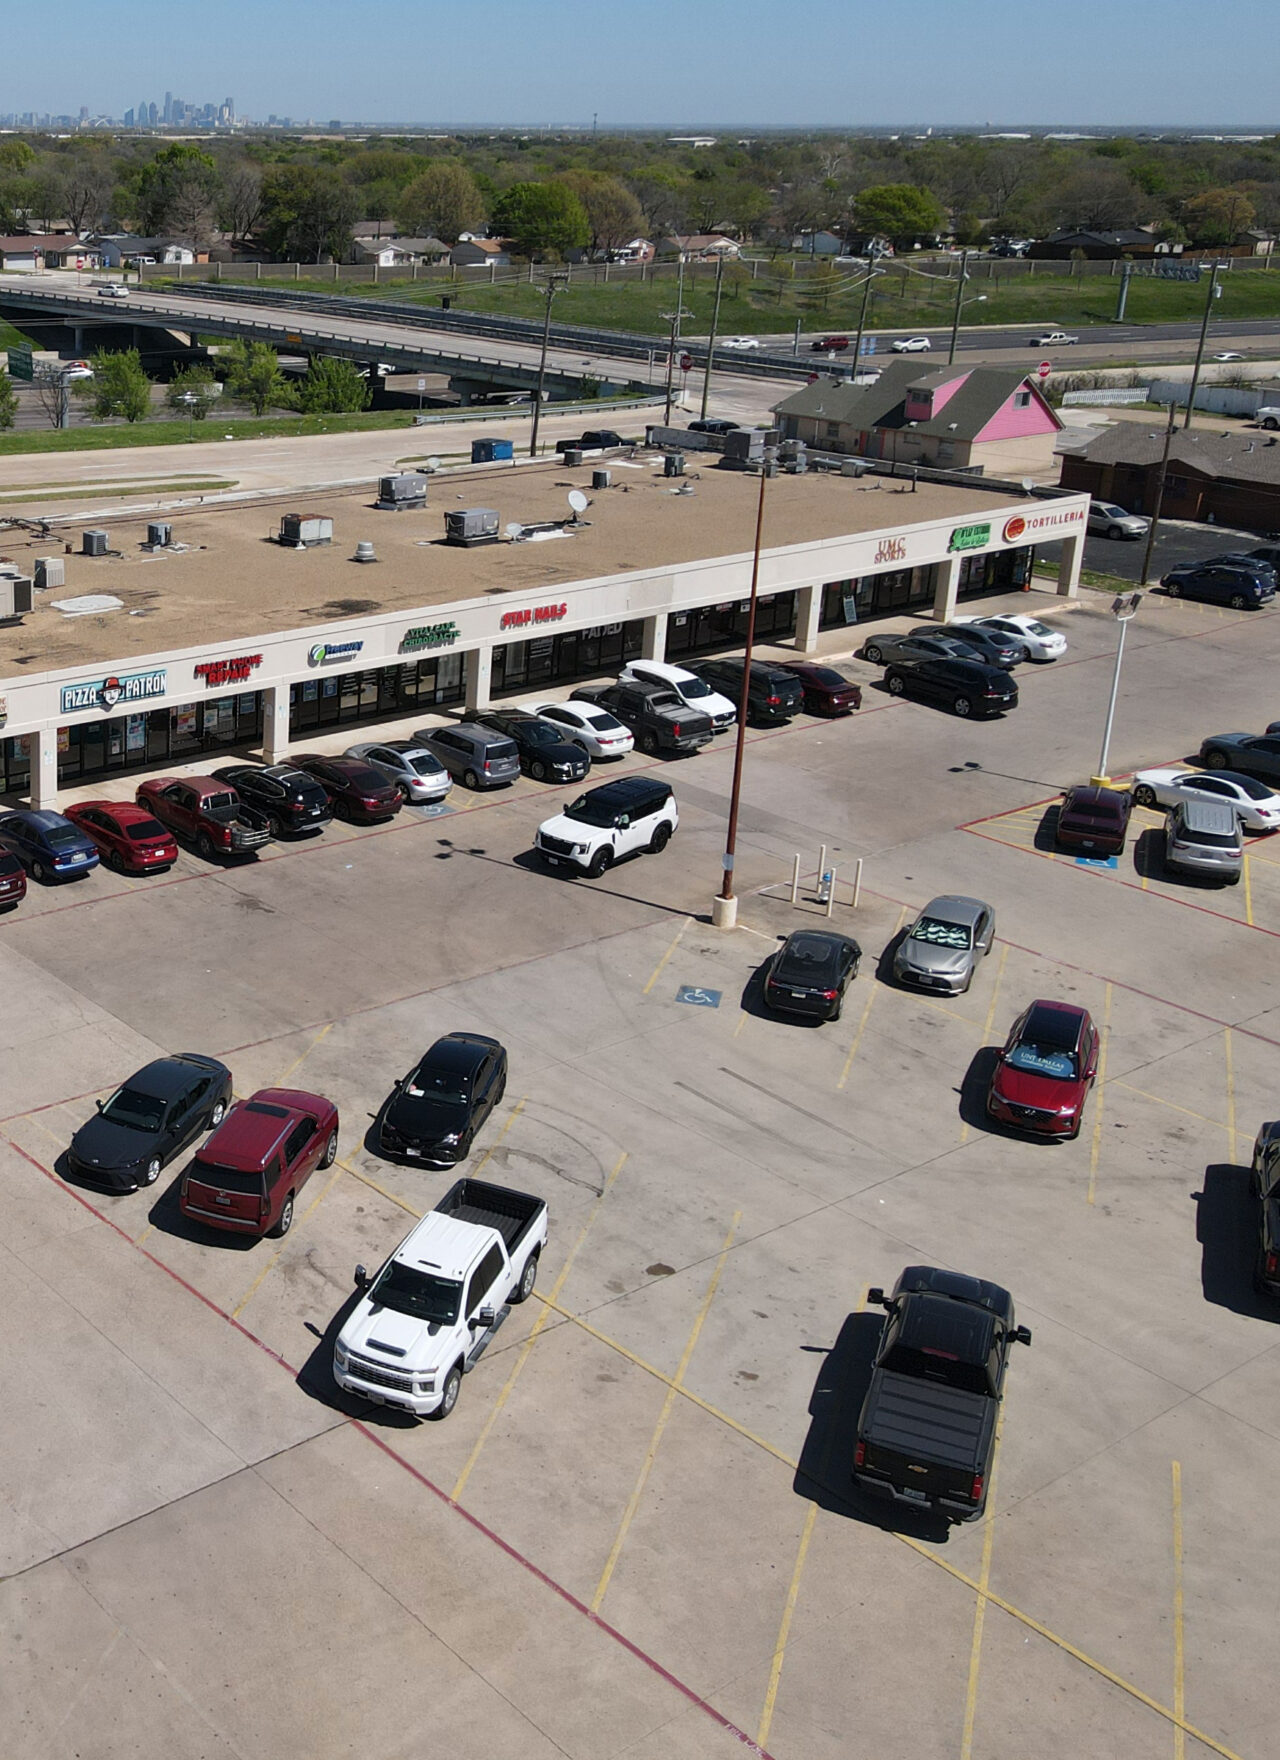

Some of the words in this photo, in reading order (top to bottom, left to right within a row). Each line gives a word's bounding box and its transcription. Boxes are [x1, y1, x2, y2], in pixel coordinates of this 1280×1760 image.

[1027, 511, 1084, 528] TORTILLERIA
[874, 549, 906, 564] SPORTS
[502, 609, 531, 626] STAR
[534, 603, 567, 620] NAILS
[196, 661, 228, 674] SMART
[231, 654, 263, 666] PHONE
[208, 667, 251, 683] REPAIR
[65, 687, 96, 708] PIZZA
[1037, 1057, 1065, 1069] DALLAS
